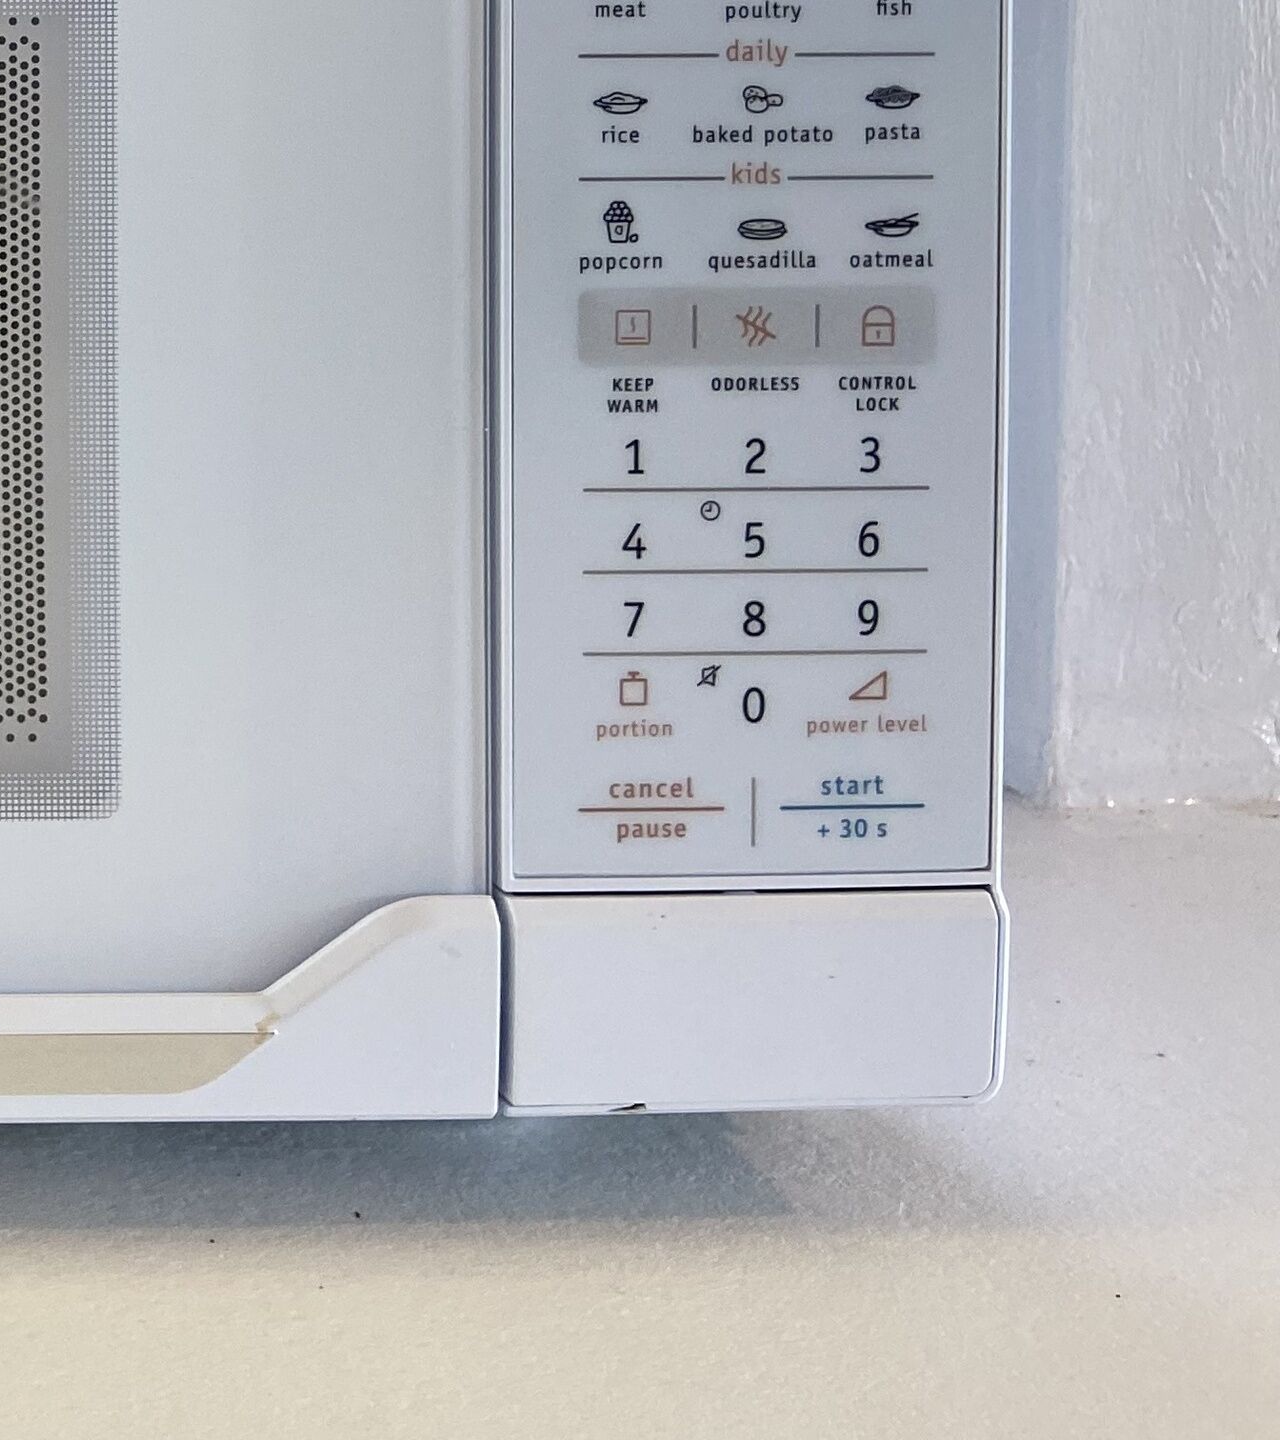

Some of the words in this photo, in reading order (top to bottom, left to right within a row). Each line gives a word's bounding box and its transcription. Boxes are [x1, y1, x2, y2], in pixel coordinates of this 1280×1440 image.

[595, 1, 646, 18] meat
[725, 0, 802, 23] poultry
[725, 39, 788, 67] daily
[601, 125, 640, 144] rice
[692, 124, 753, 144] baked
[763, 125, 834, 147] potato
[864, 122, 921, 145] pasta
[731, 162, 782, 186] kids
[579, 252, 663, 274] popcorn
[707, 250, 817, 273] quesadilla
[849, 248, 934, 269] oatmeal
[612, 377, 654, 393] KEEP
[710, 376, 801, 393] ODORLESS
[838, 376, 918, 392] CONTROL
[606, 398, 660, 414] WARM
[855, 396, 902, 412] LOCK
[624, 439, 646, 475] 1
[744, 438, 767, 475] 2
[859, 436, 882, 474] 3
[621, 523, 648, 560] 4
[743, 522, 767, 559] 5
[857, 520, 881, 558] 6
[623, 601, 647, 638] 7
[742, 600, 768, 638] 8
[857, 598, 881, 637] 9
[742, 686, 768, 725] 0
[595, 718, 673, 741] portion
[806, 718, 868, 738] power
[877, 714, 928, 734] level
[608, 776, 695, 800] cancel
[820, 775, 885, 797] start
[616, 822, 688, 844] pause
[840, 818, 869, 839] 30
[877, 820, 889, 838] s
